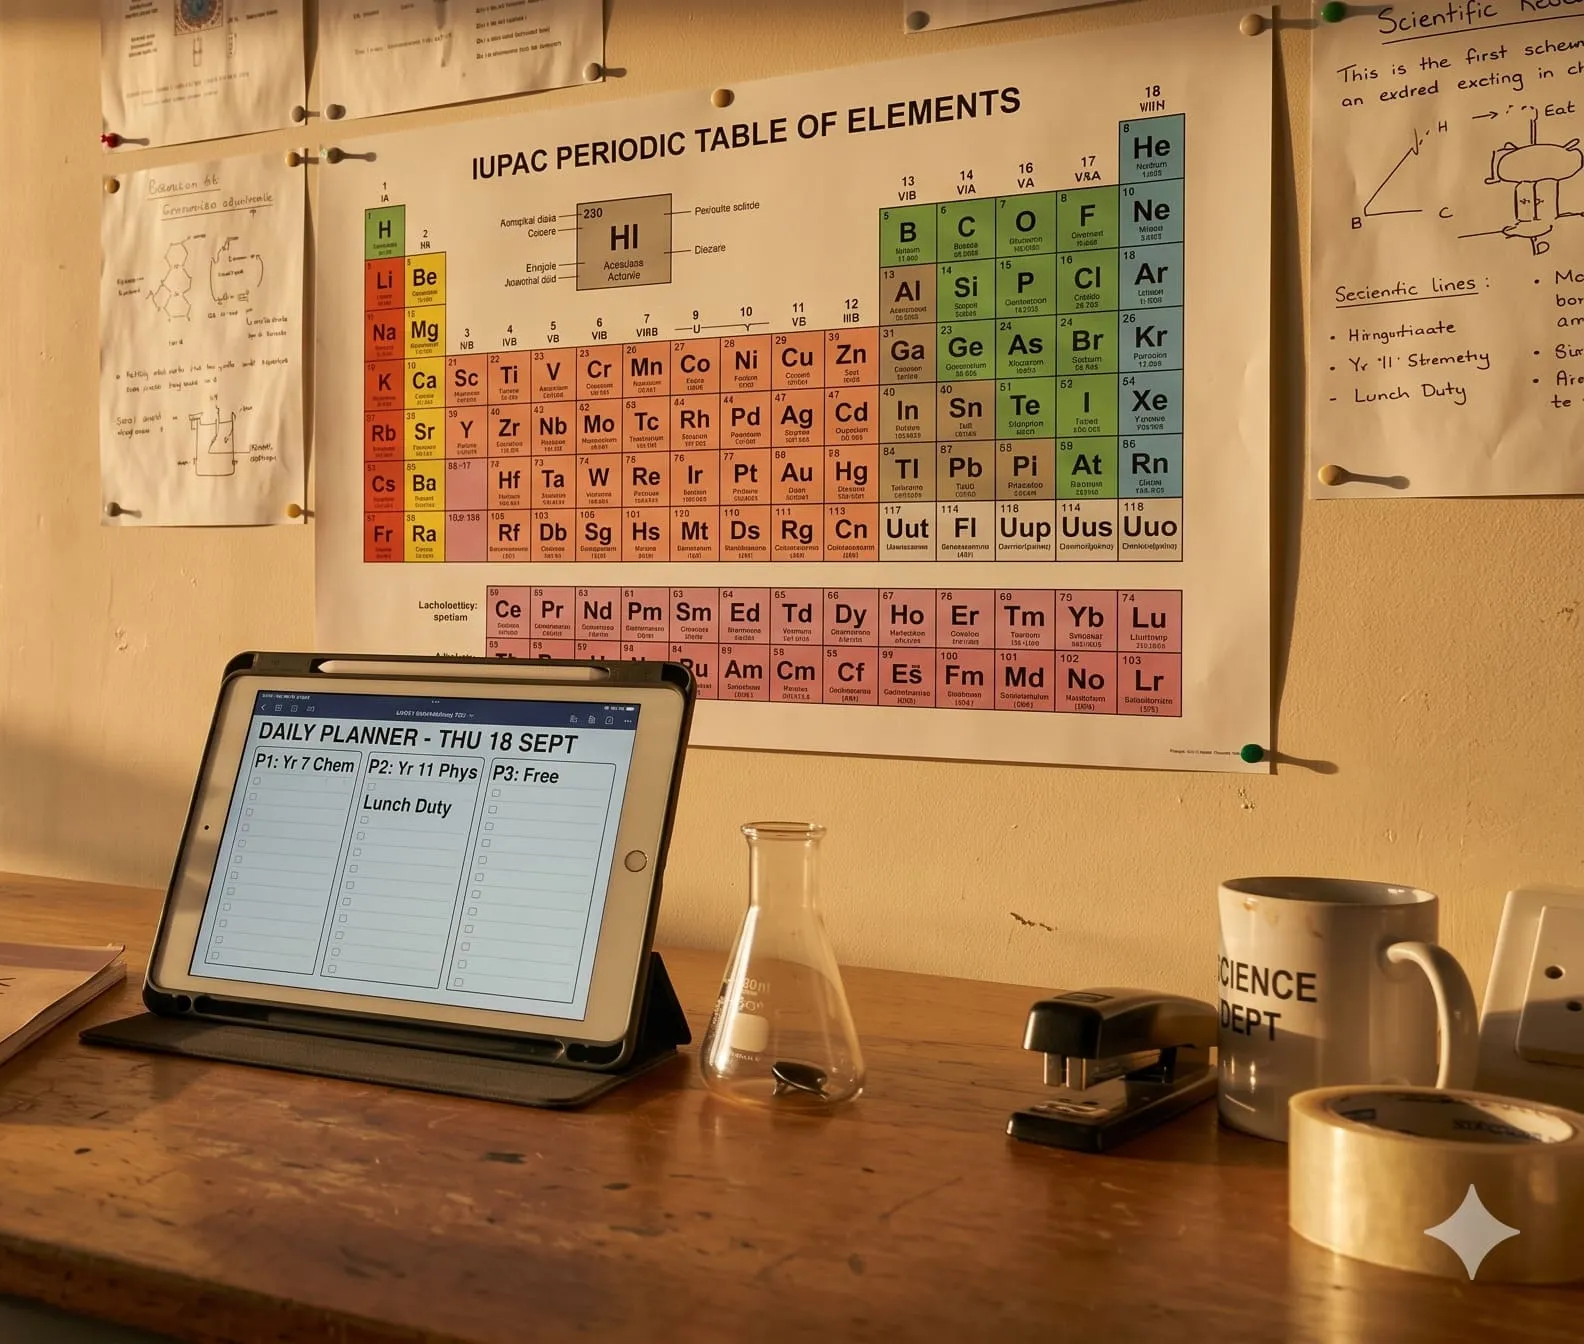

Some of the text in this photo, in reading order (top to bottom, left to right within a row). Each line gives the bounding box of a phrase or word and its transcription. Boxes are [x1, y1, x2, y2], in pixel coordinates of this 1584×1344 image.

[1378, 1, 1498, 34] Scientific
[1337, 64, 1378, 82] This
[1393, 64, 1406, 74] is
[1420, 57, 1451, 70] the
[1466, 45, 1507, 64] first
[1146, 85, 1160, 98] 18
[1342, 98, 1363, 106] an
[1380, 80, 1438, 101] exdred
[1458, 73, 1523, 91] excting
[1539, 68, 1553, 78] in
[1545, 101, 1575, 116] Eat
[473, 87, 1021, 179] IUPAC PERIODIC TABLE OF ELEMENTS
[1439, 121, 1447, 132] H
[1134, 136, 1170, 159] He
[1019, 163, 1033, 173] 16
[1081, 156, 1096, 167] 17
[902, 176, 914, 186] 13
[960, 170, 973, 180] 14
[1018, 178, 1034, 188] VA
[898, 191, 916, 201] VIB
[957, 184, 976, 195] VIA
[584, 208, 602, 219] 230
[1081, 204, 1095, 226] F
[1134, 200, 1170, 222] Ne
[1439, 207, 1453, 218] C
[379, 220, 390, 239] H
[958, 216, 975, 237] C
[1016, 211, 1036, 232] O
[1352, 217, 1362, 229] B
[900, 222, 916, 242] B
[377, 271, 392, 289] Li
[414, 269, 436, 286] Be
[1018, 272, 1034, 293] P
[1075, 267, 1100, 289] Cl
[1135, 263, 1168, 285] Ar
[895, 281, 920, 302] Al
[955, 276, 977, 297] Si
[741, 307, 752, 316] 10
[793, 303, 803, 312] 11
[845, 299, 858, 309] 12
[507, 325, 512, 333] 4
[597, 318, 602, 327] 6
[792, 317, 806, 326] VB
[374, 324, 396, 341] Na
[412, 321, 438, 342] Mg
[592, 331, 607, 340] VIB
[1136, 326, 1167, 348] Kr
[503, 338, 517, 346] IVB
[891, 341, 924, 361] Ga
[736, 350, 757, 370] Ni
[782, 348, 812, 367] Cu
[836, 344, 866, 364] Zn
[547, 363, 560, 380] V
[588, 360, 612, 378] Cr
[632, 358, 662, 376] Mn
[681, 355, 710, 373] Co
[1349, 357, 1367, 372] Yr
[413, 372, 436, 389] Ca
[455, 369, 478, 387] Sc
[500, 366, 517, 384] Ti
[1132, 390, 1167, 411] Xe
[1355, 382, 1466, 405] Lunch Duty
[950, 398, 982, 418] Sn
[1010, 395, 1040, 415] Te
[585, 415, 614, 433] Mo
[781, 405, 812, 429] Ag
[781, 463, 812, 482] Au
[836, 461, 867, 485] Hg
[950, 457, 982, 477] Pb
[1014, 456, 1036, 476] Pi
[1072, 455, 1102, 475] At
[1132, 453, 1168, 474] Rn
[735, 464, 757, 483] Pt
[885, 506, 901, 514] 117
[942, 505, 958, 513] 114
[1125, 503, 1144, 511] 118
[585, 523, 611, 545] Sg
[633, 522, 660, 540] Hs
[836, 519, 867, 539] Cn
[887, 519, 928, 538] Uut
[955, 518, 975, 537] Fl
[1001, 517, 1051, 542] Uup
[1063, 517, 1112, 537] Uus
[1124, 516, 1177, 537] Uuo
[496, 600, 521, 618] Ce
[676, 602, 711, 621] Sm
[731, 603, 759, 622] Ed
[892, 605, 924, 624] Ho
[1068, 607, 1103, 627] Yb
[1133, 607, 1165, 628] Lu
[725, 660, 762, 679] Am
[1123, 656, 1141, 664] 103
[946, 665, 983, 686] Fm
[1069, 668, 1104, 689] No
[1136, 670, 1164, 691] Lr
[259, 722, 316, 741] DAILY
[320, 725, 418, 746] PLANNER
[440, 730, 481, 749] THU
[491, 732, 512, 751] 18
[519, 733, 578, 753] SEPT
[254, 753, 354, 772] P1: Yr 7 Chem
[367, 756, 477, 782] P2: Yr 11 Phys
[493, 765, 559, 783] P3: Free
[364, 795, 451, 818] Lunch Duty
[1218, 954, 1317, 1002] CIENCE
[1221, 999, 1281, 1041] DEPT
